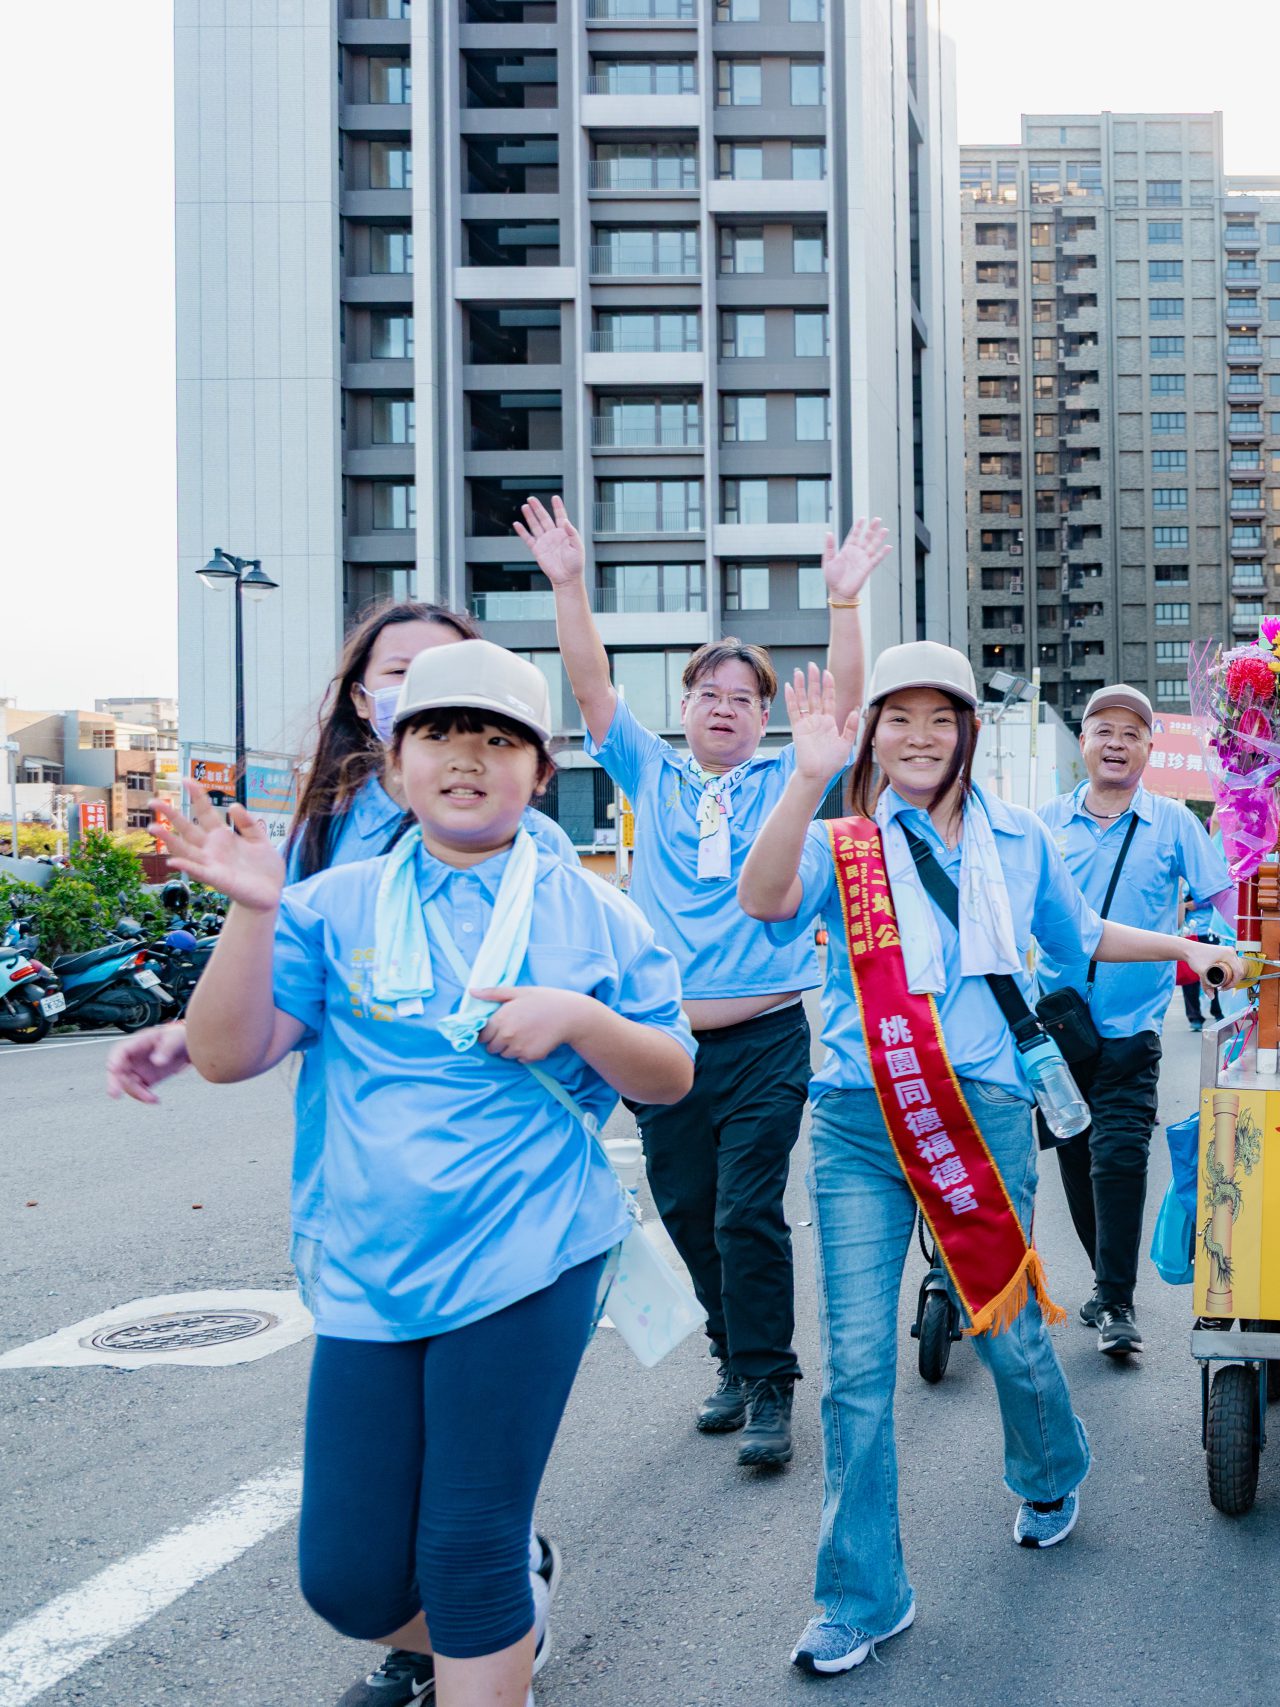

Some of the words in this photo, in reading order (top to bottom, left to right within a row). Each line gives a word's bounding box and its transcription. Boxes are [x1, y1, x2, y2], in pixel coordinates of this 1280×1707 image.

[1148, 751, 1218, 772] 碧珍舞
[879, 1016, 979, 1216] 桃園同德福德宮
